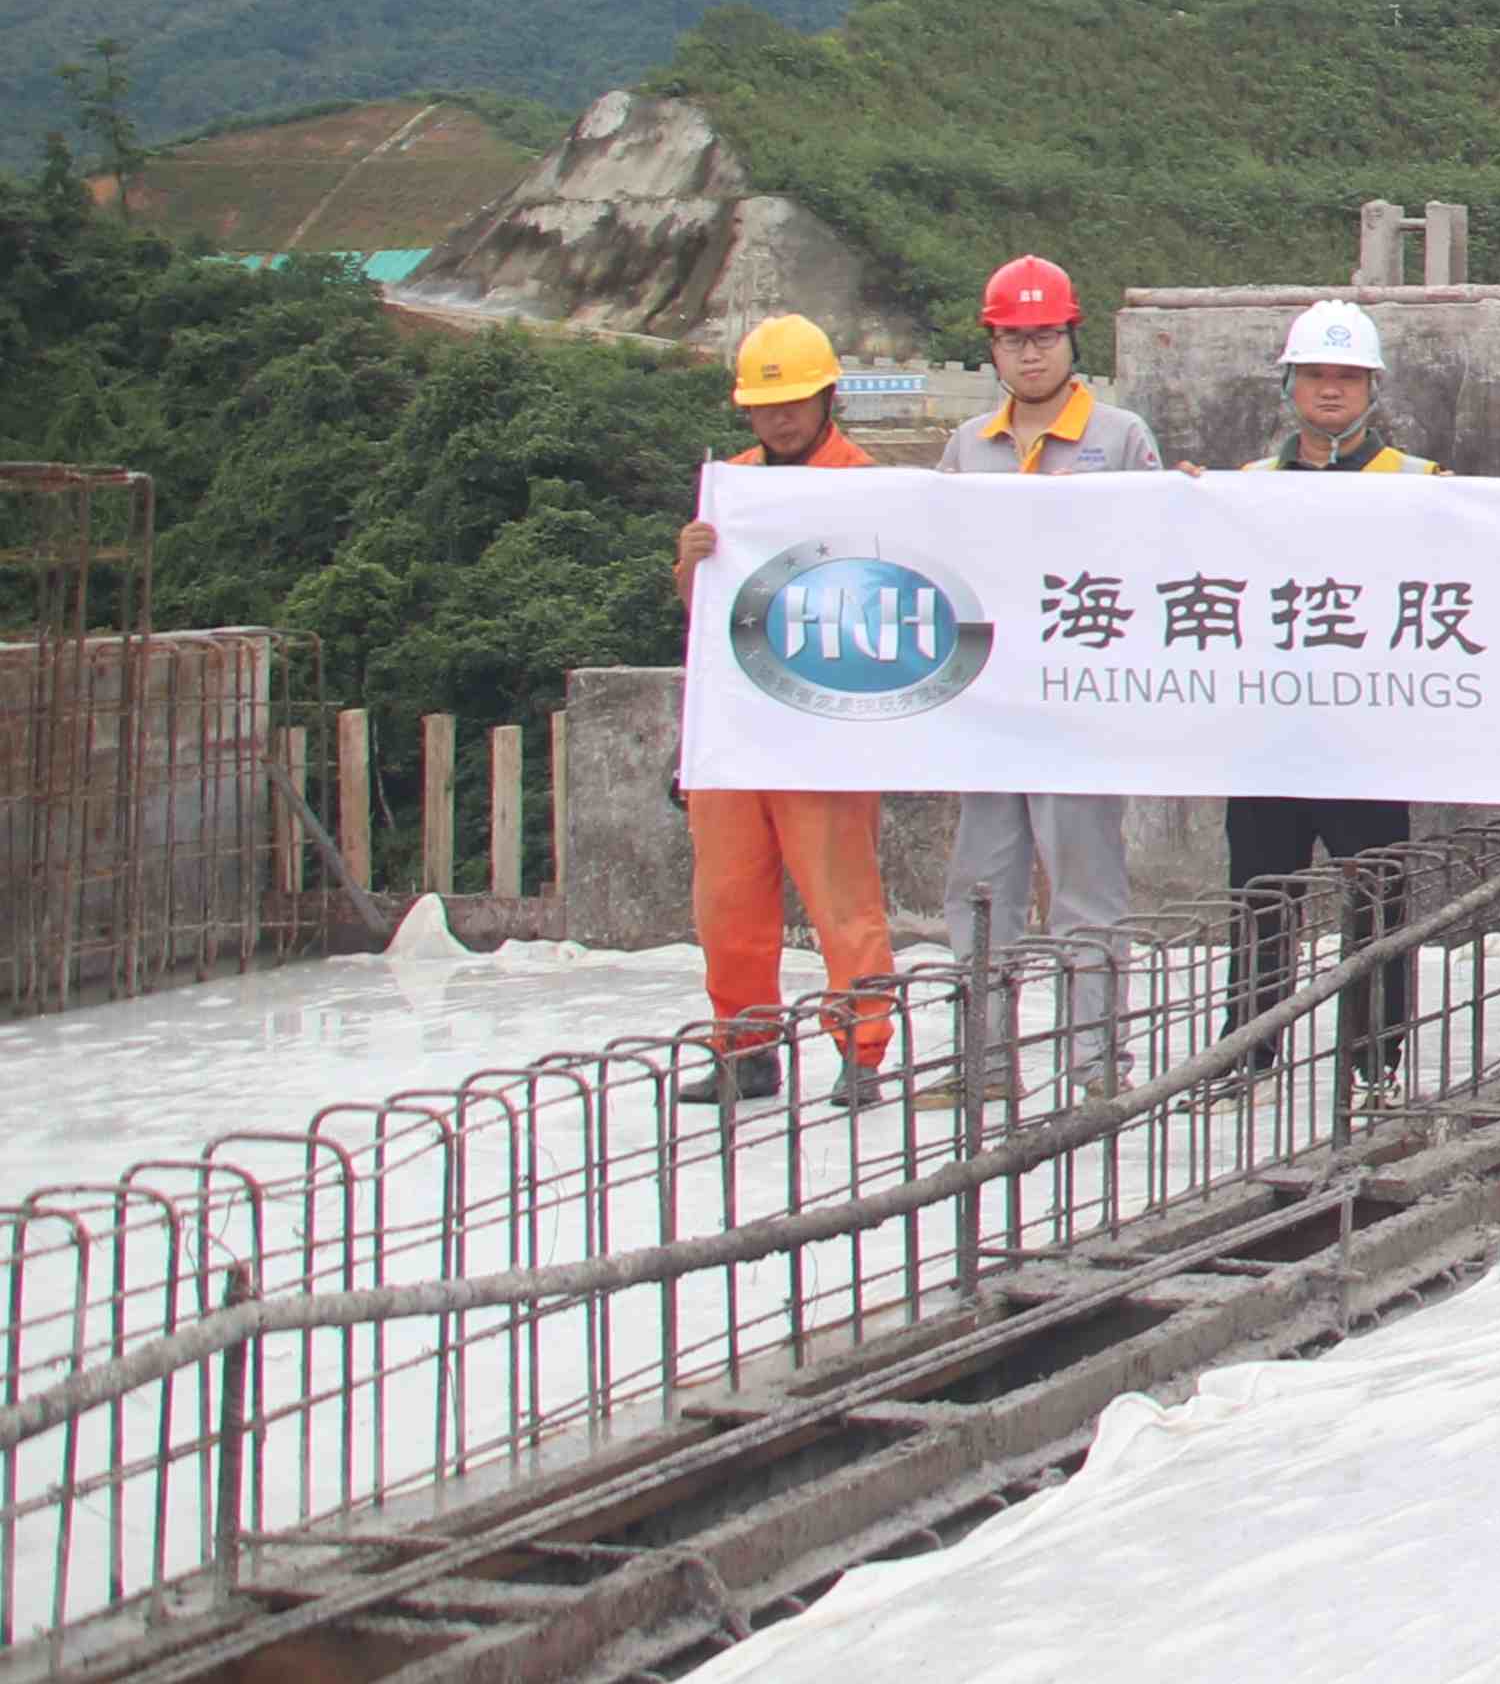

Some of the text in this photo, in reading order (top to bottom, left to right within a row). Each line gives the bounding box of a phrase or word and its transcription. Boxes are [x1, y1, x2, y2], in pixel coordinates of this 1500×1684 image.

[1041, 571, 1487, 655] 海南控股
[1041, 666, 1483, 709] HAINAN HOLDINGS
